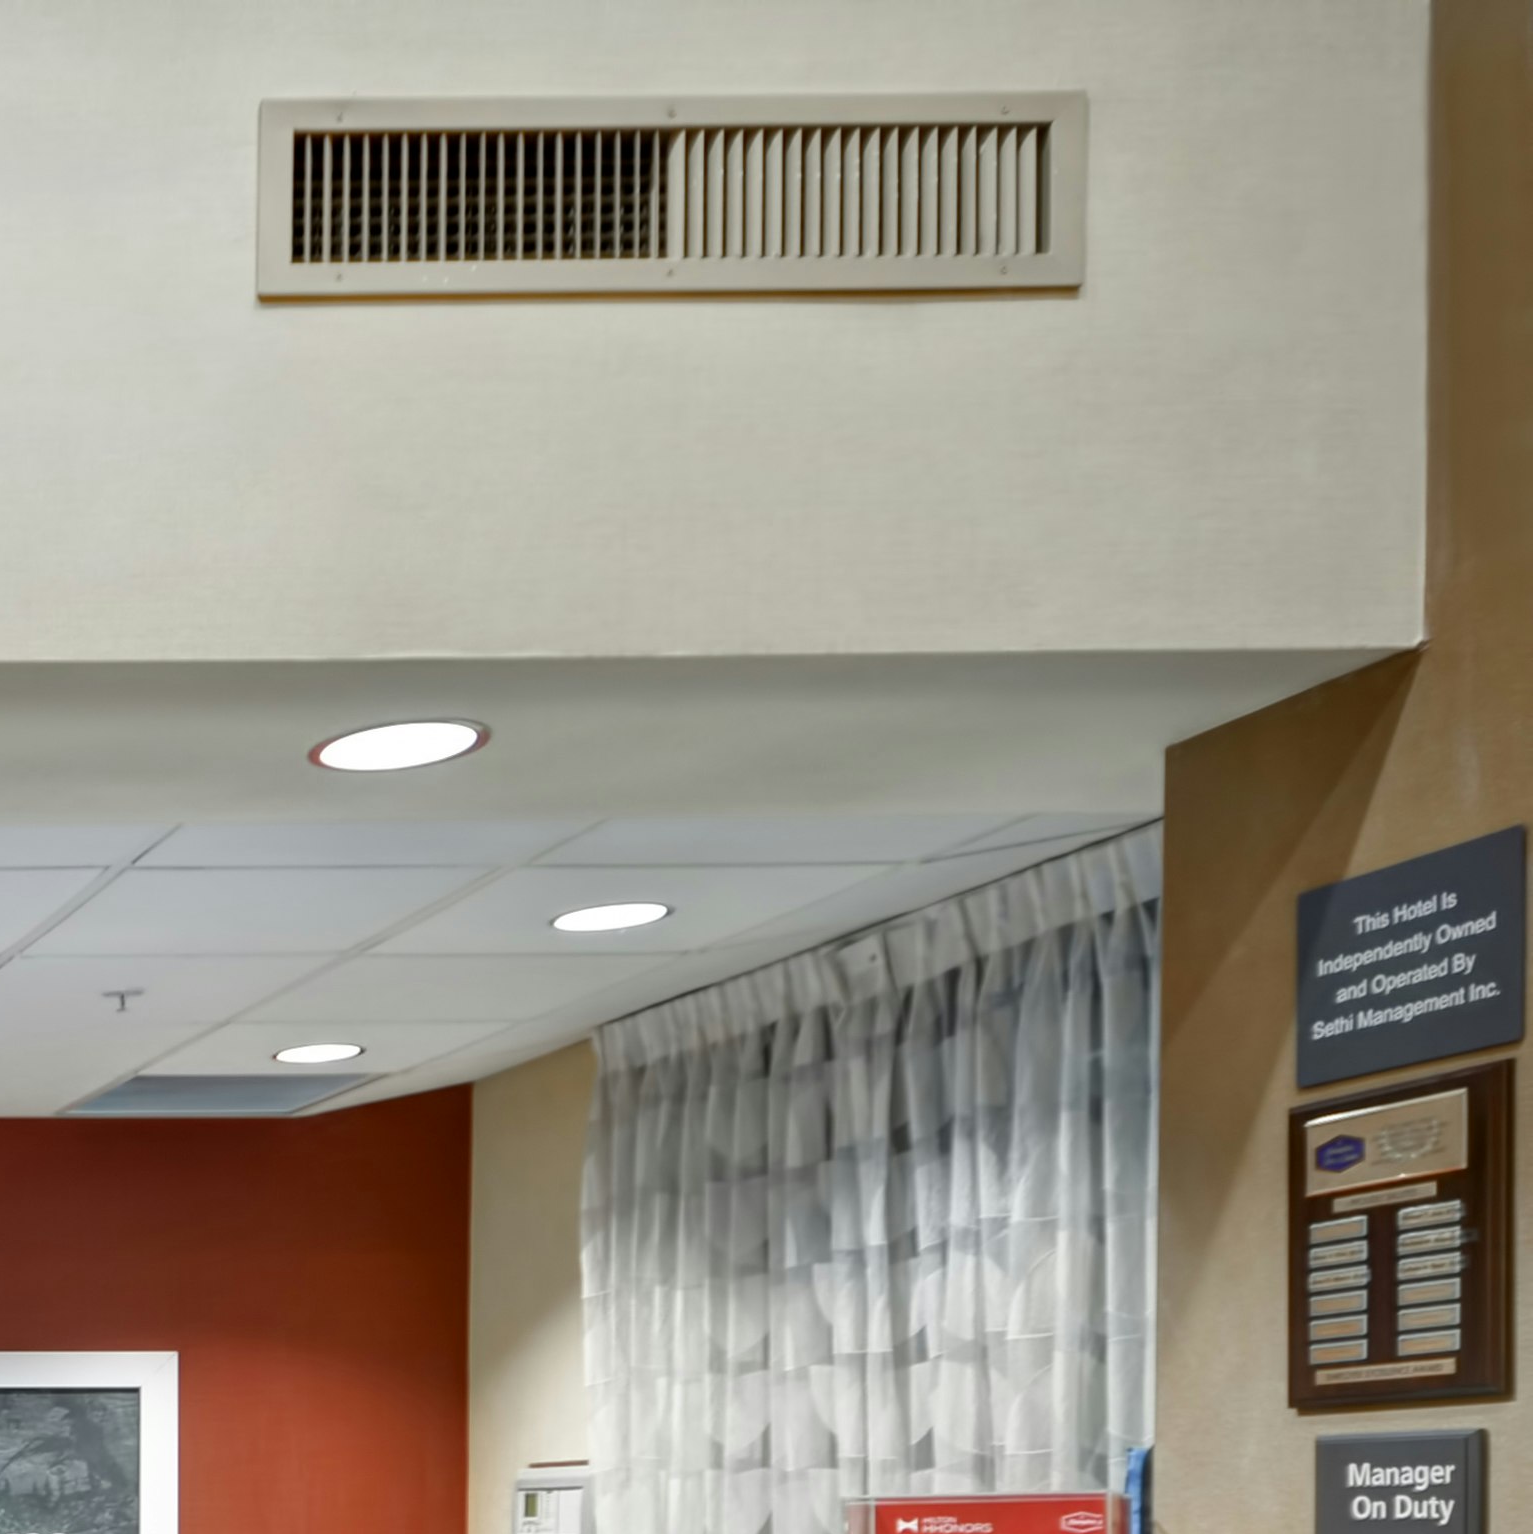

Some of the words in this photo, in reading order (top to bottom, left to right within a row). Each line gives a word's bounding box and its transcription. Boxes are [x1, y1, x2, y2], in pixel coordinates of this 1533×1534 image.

[1353, 912, 1389, 934] This
[1392, 895, 1437, 925] Hotel
[1440, 891, 1458, 911] Is
[1317, 932, 1433, 977] Independently
[1435, 911, 1497, 944] Owned
[1335, 979, 1367, 1003] and
[1371, 958, 1448, 995] Operated
[1451, 953, 1477, 975] By
[1311, 1014, 1354, 1040] Sethi
[1357, 987, 1465, 1023] Management
[1468, 982, 1501, 1002] Inc.
[1346, 1462, 1456, 1492] Manager
[1350, 1495, 1387, 1519] On
[1393, 1494, 1455, 1526] Duty
